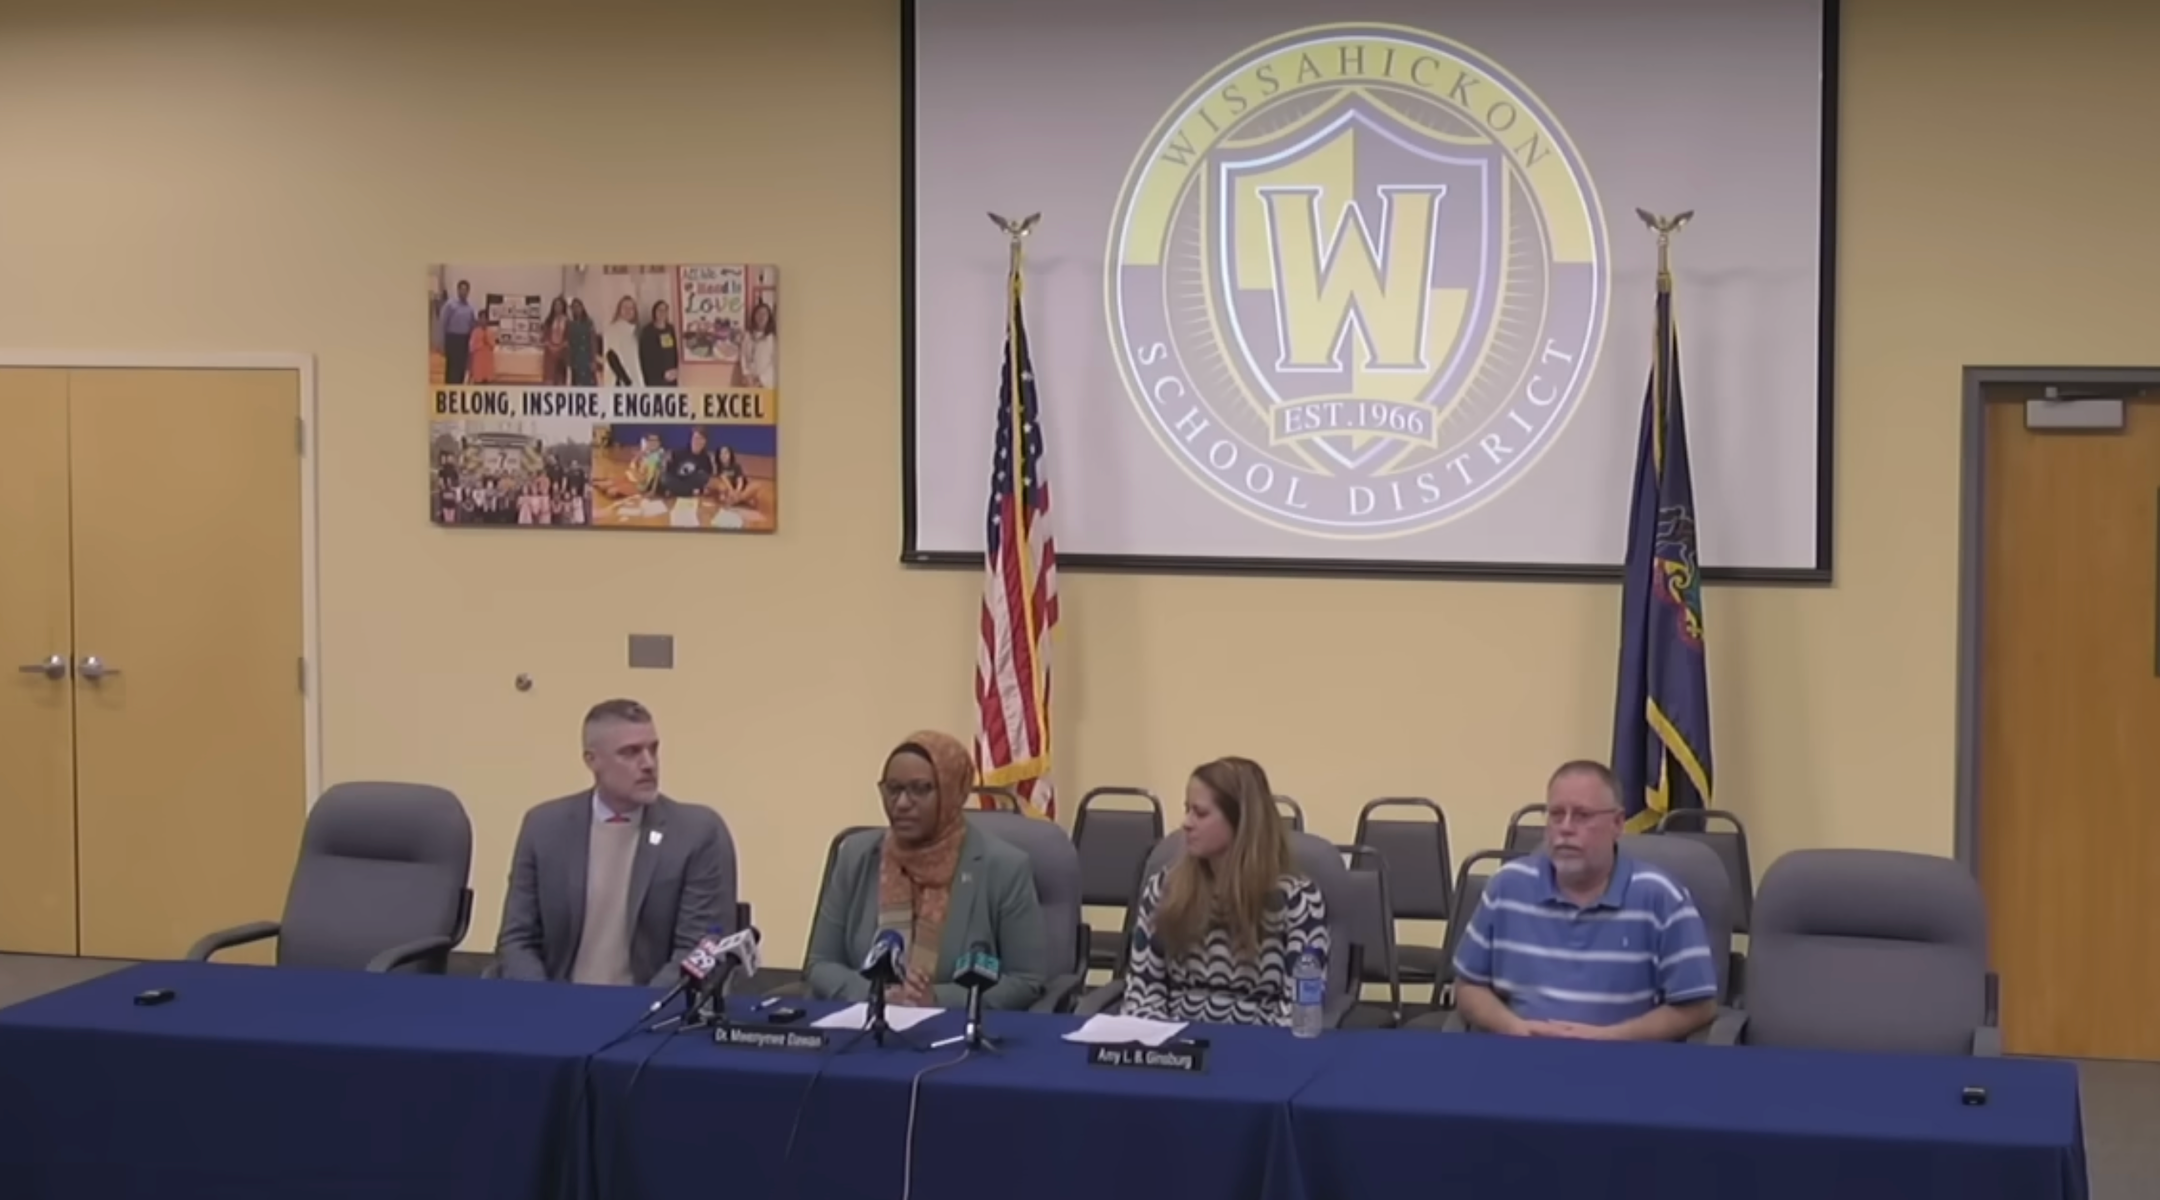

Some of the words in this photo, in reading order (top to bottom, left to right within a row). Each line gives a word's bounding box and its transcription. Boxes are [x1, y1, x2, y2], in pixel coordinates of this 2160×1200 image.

[1161, 44, 1552, 171] WISSAHICKON
[1256, 184, 1447, 373] W
[435, 390, 516, 418] BELONG,
[522, 391, 606, 420] INSPIRE,
[612, 393, 697, 421] ENGAGE,
[703, 394, 765, 419] EXCEL
[1138, 340, 1309, 510] SCHOOL
[1348, 338, 1573, 517] DISTRICT
